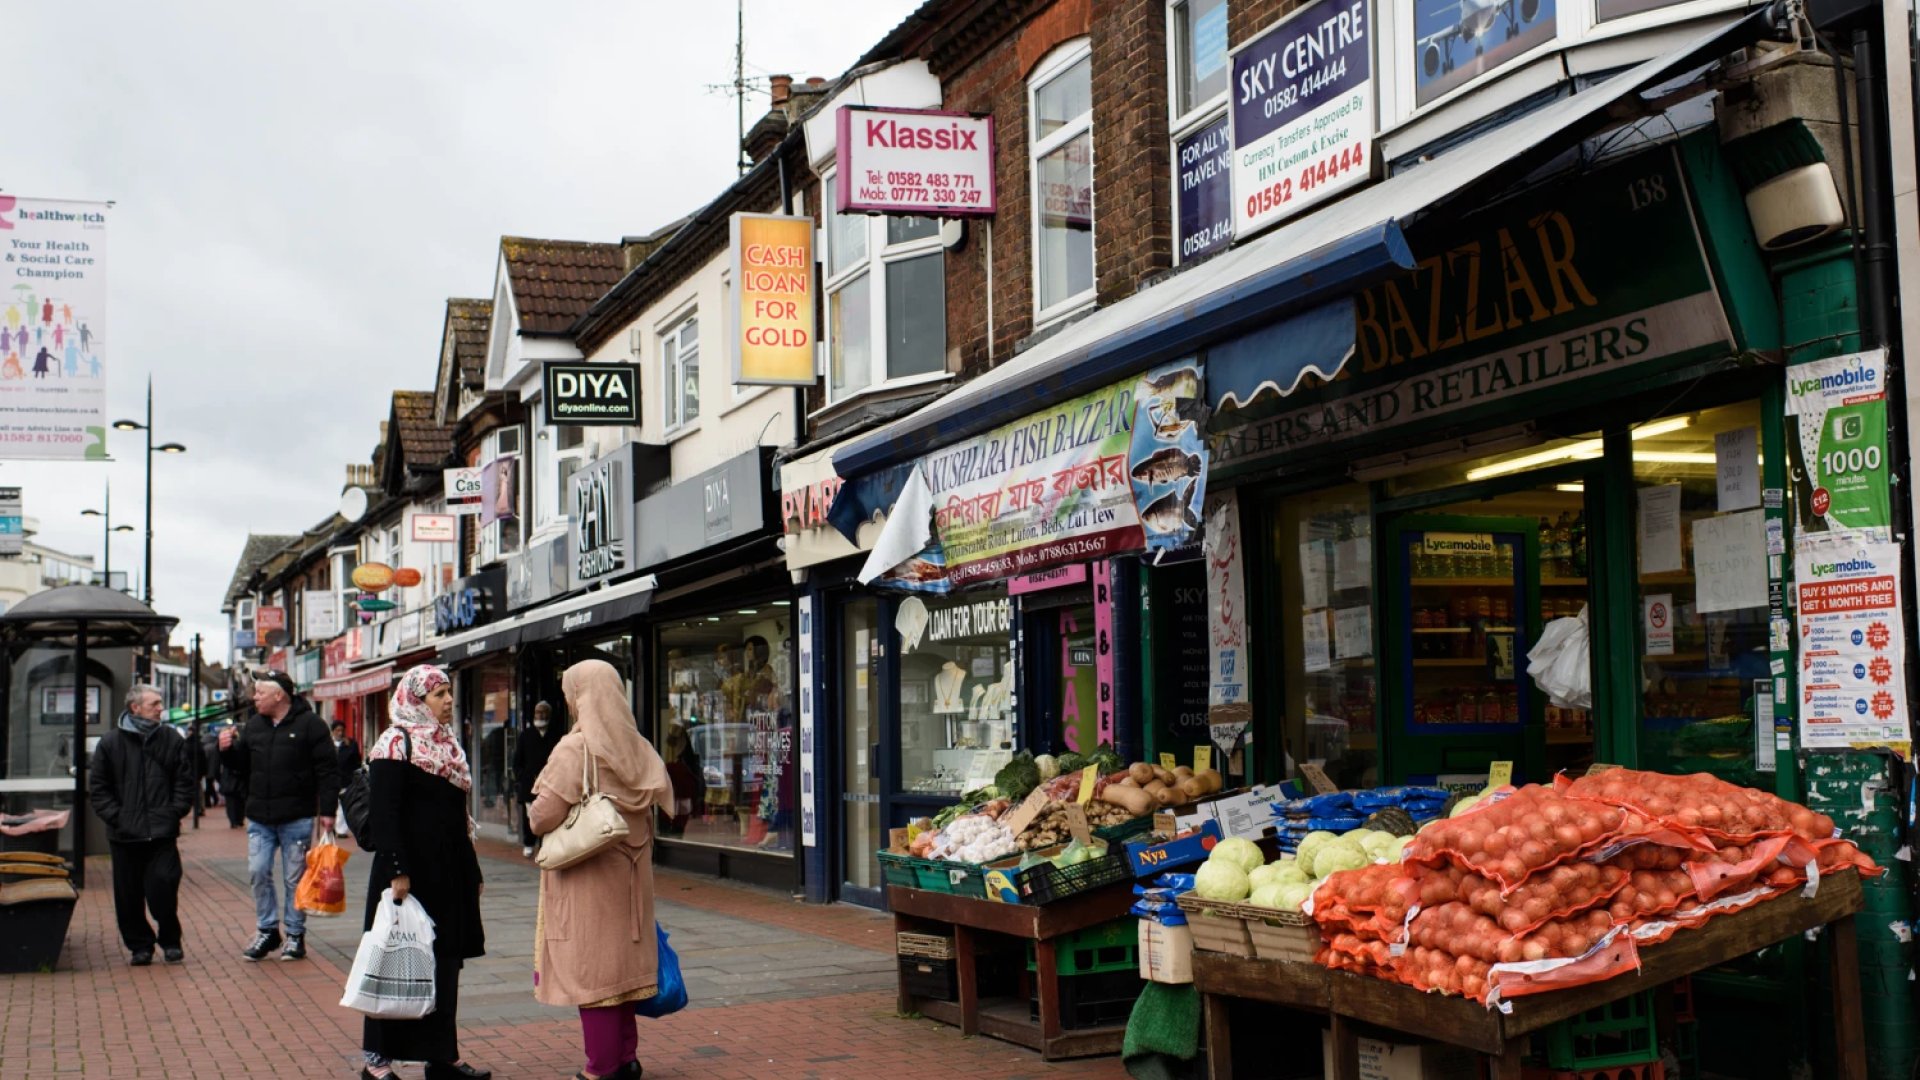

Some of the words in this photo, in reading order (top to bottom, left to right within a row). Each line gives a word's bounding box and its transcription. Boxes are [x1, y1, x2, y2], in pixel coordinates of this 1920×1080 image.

[1240, 53, 1277, 105] SKY
[1282, 4, 1363, 78] CENTRE
[1265, 88, 1298, 118] 01582
[1300, 56, 1347, 98] 414444
[866, 119, 978, 151] Klassix
[1243, 144, 1275, 167] Currency
[1278, 121, 1310, 148] Transfers
[1313, 102, 1351, 132] Approved
[1352, 95, 1364, 113] By
[1182, 144, 1200, 167] FOR
[1202, 133, 1218, 157] ALL
[1258, 162, 1276, 182] HM
[1278, 148, 1309, 172] Custom
[1311, 141, 1318, 154] &
[1320, 127, 1349, 150] Excise
[866, 170, 884, 185] Tel:
[887, 172, 922, 186] 01582
[926, 173, 949, 186] 483
[954, 174, 974, 187] 771
[1182, 160, 1216, 191] TRAVEL
[1247, 178, 1292, 218] 01582
[1300, 142, 1363, 192] 414444
[860, 187, 887, 200] Mob:
[891, 188, 928, 202] 07772
[933, 189, 955, 202] 330
[960, 190, 981, 204] 247
[1626, 173, 1667, 212] 138
[19, 208, 105, 222] healthwatch
[11, 239, 41, 249] Your
[45, 240, 89, 251] Health
[1183, 230, 1210, 256] 01582
[5, 253, 15, 262] &
[20, 254, 60, 264] Social
[64, 255, 94, 265] Care
[746, 246, 804, 267] CASH
[16, 267, 84, 280] Champion
[745, 272, 806, 294] LOAN
[1356, 209, 1598, 371] BAZZAR
[755, 300, 798, 320] FOR
[745, 327, 807, 347] GOLD
[557, 373, 628, 399] DIYA
[1322, 384, 1401, 440] AND
[1411, 317, 1650, 415] RETAILERS
[1791, 366, 1876, 396] Lycamobile
[558, 402, 629, 414] diyaonline.com
[931, 435, 1008, 495] KUSHIARA
[1010, 418, 1052, 469] FISH
[1053, 389, 1132, 455] BAZZAR
[1822, 445, 1881, 475] 1000
[1836, 474, 1866, 485] minutes
[706, 477, 729, 512] DIYA
[1426, 537, 1492, 552] Lycamobile
[578, 545, 616, 580] FASHIONS
[1016, 551, 1038, 566] Mob:
[1174, 588, 1206, 605] SKY
[1802, 587, 1819, 598] BUY
[1821, 586, 1826, 596] 2
[1828, 582, 1868, 596] MONTHS
[1871, 580, 1893, 591] AND
[1802, 600, 1820, 611] GET
[1822, 599, 1827, 609] 1
[1829, 596, 1863, 608] MONTH
[1865, 593, 1892, 604] FREE
[929, 610, 951, 642] LOAN
[952, 605, 970, 638] FOR
[972, 599, 996, 635] YOUR
[1099, 630, 1110, 656] &
[768, 731, 791, 750] HAVES
[1138, 849, 1168, 866] Nya
